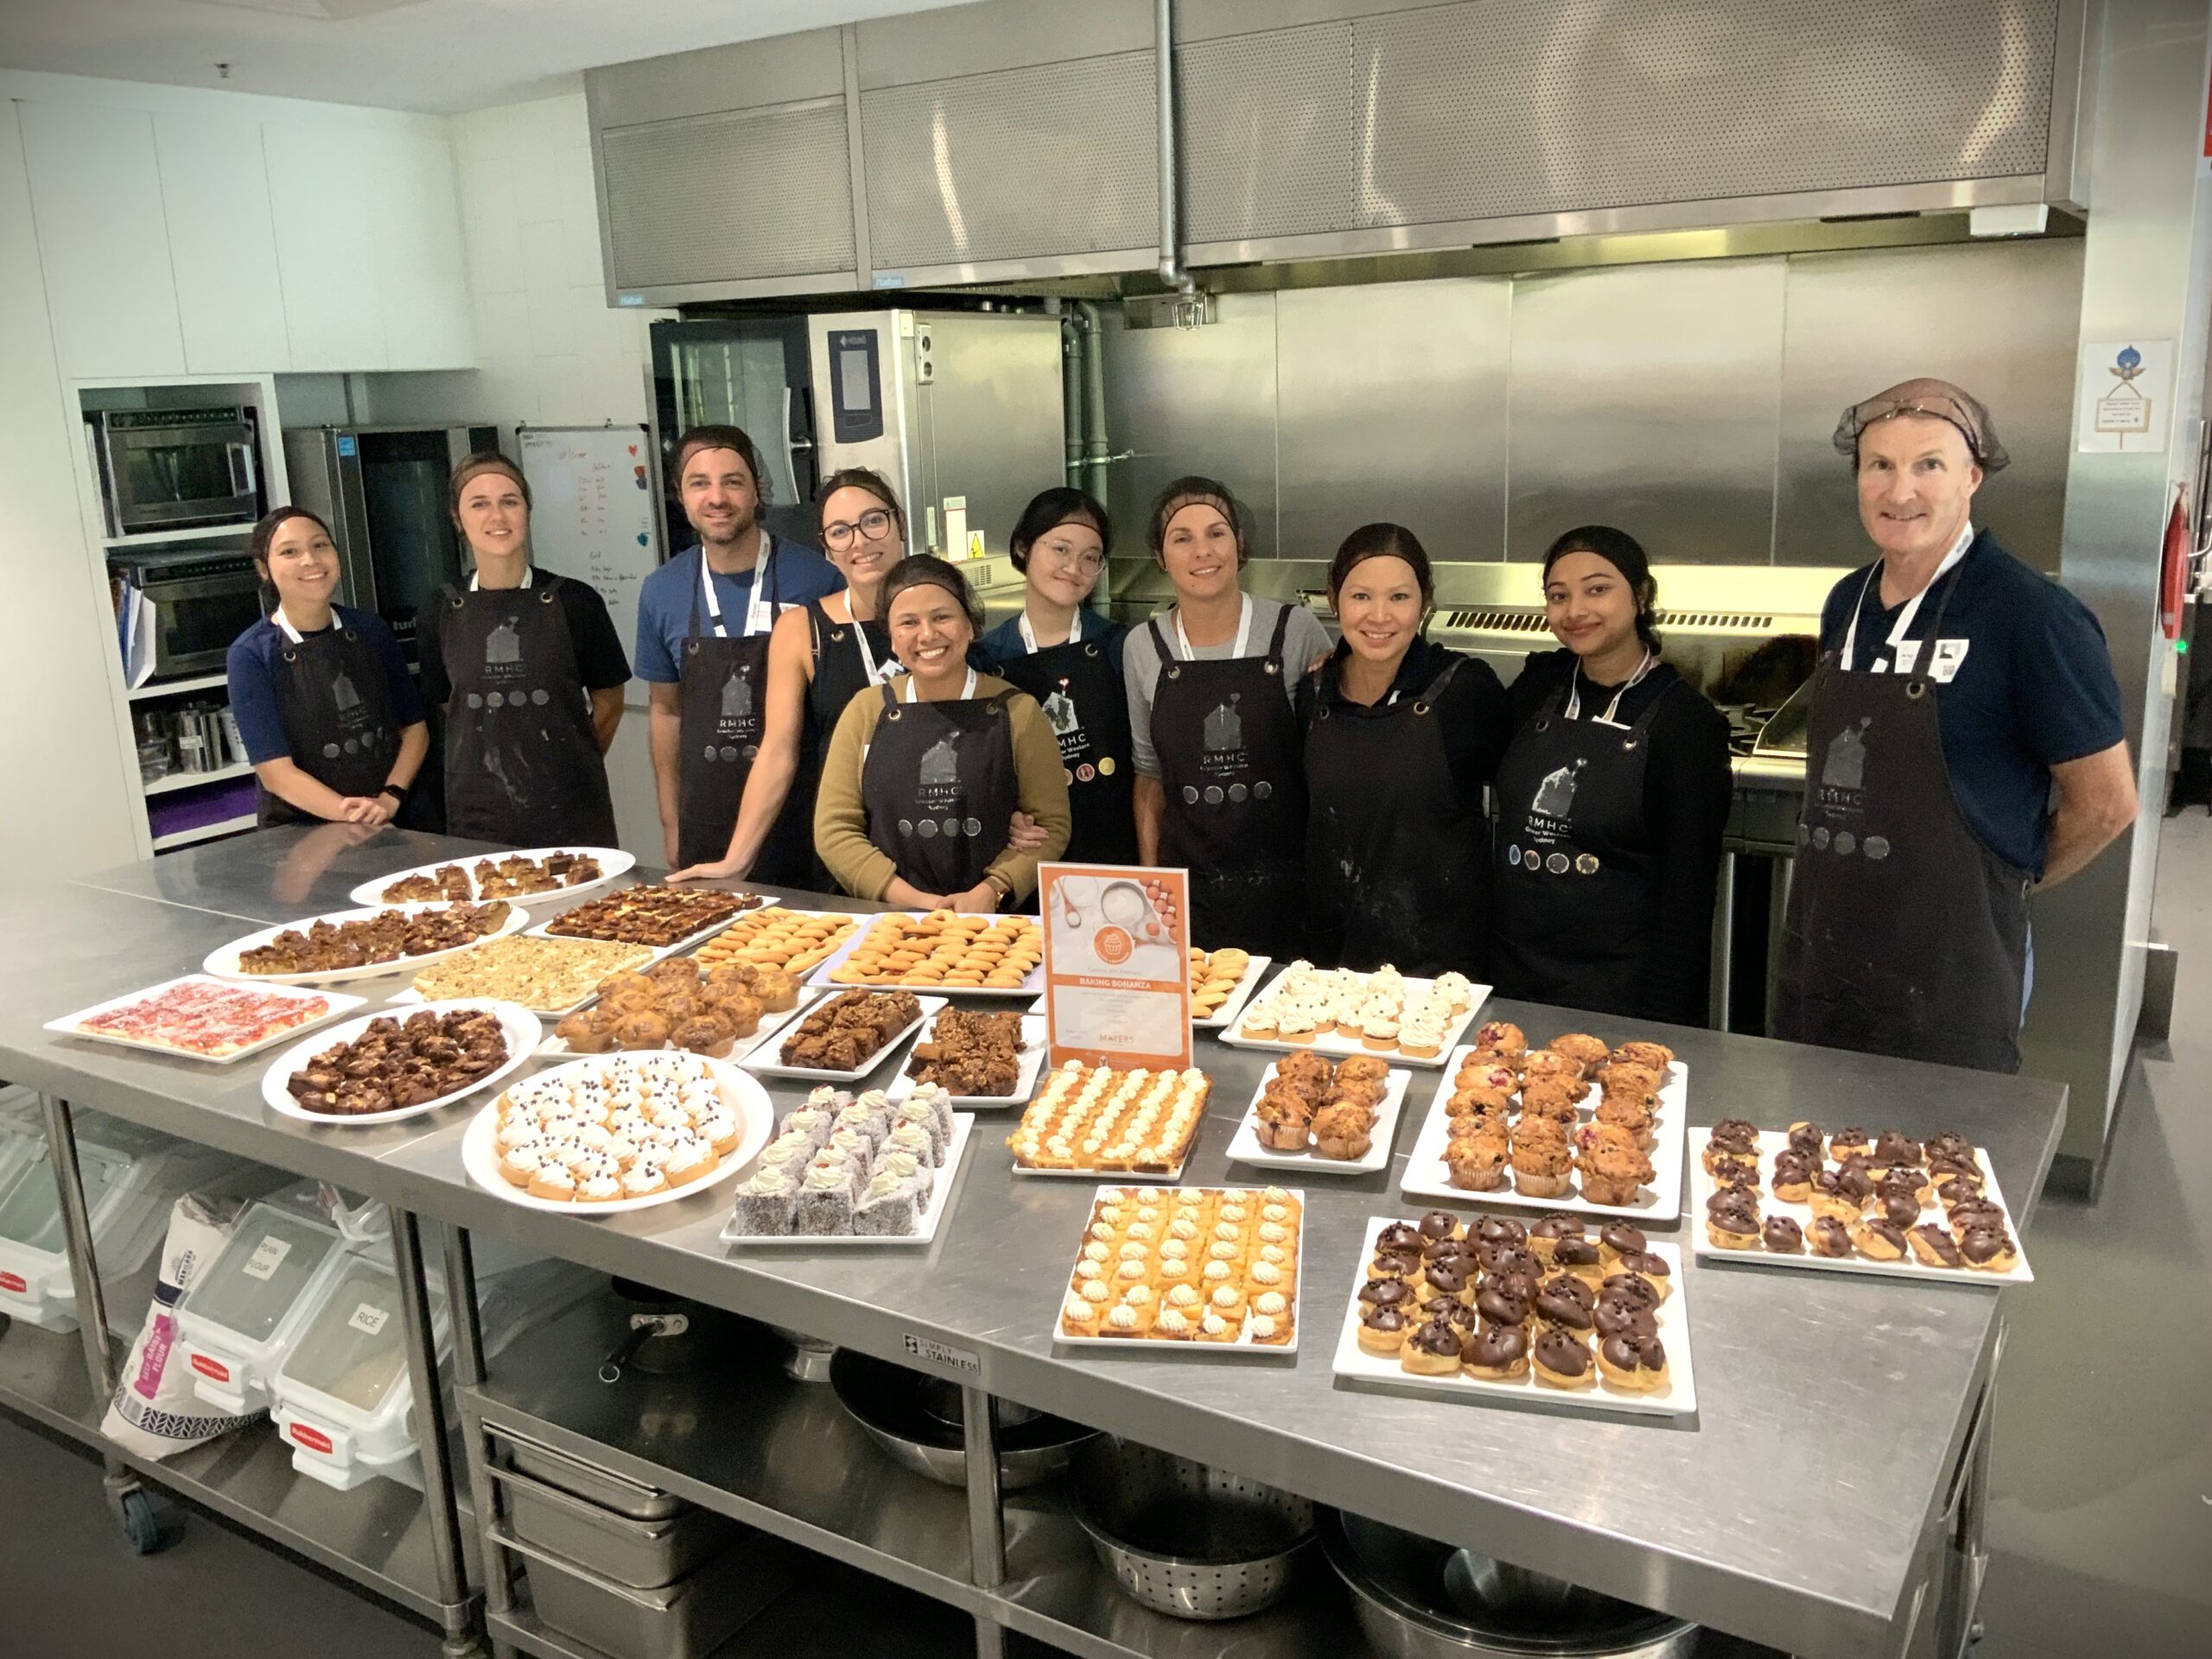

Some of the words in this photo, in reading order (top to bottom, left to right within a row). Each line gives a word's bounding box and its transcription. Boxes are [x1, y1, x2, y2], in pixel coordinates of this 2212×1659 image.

[720, 718, 756, 728] RMHC
[1203, 753, 1246, 765] RMHC
[1079, 977, 1110, 987] BAKING
[1111, 980, 1152, 989] BONANZA
[249, 1259, 270, 1272] FLOUR
[357, 1312, 380, 1328] RICE
[919, 1338, 953, 1355] SIMPLY
[152, 1343, 168, 1373] FLOUR
[925, 1349, 978, 1372] STAINLESS
[291, 1426, 332, 1450] Rubbermaid
